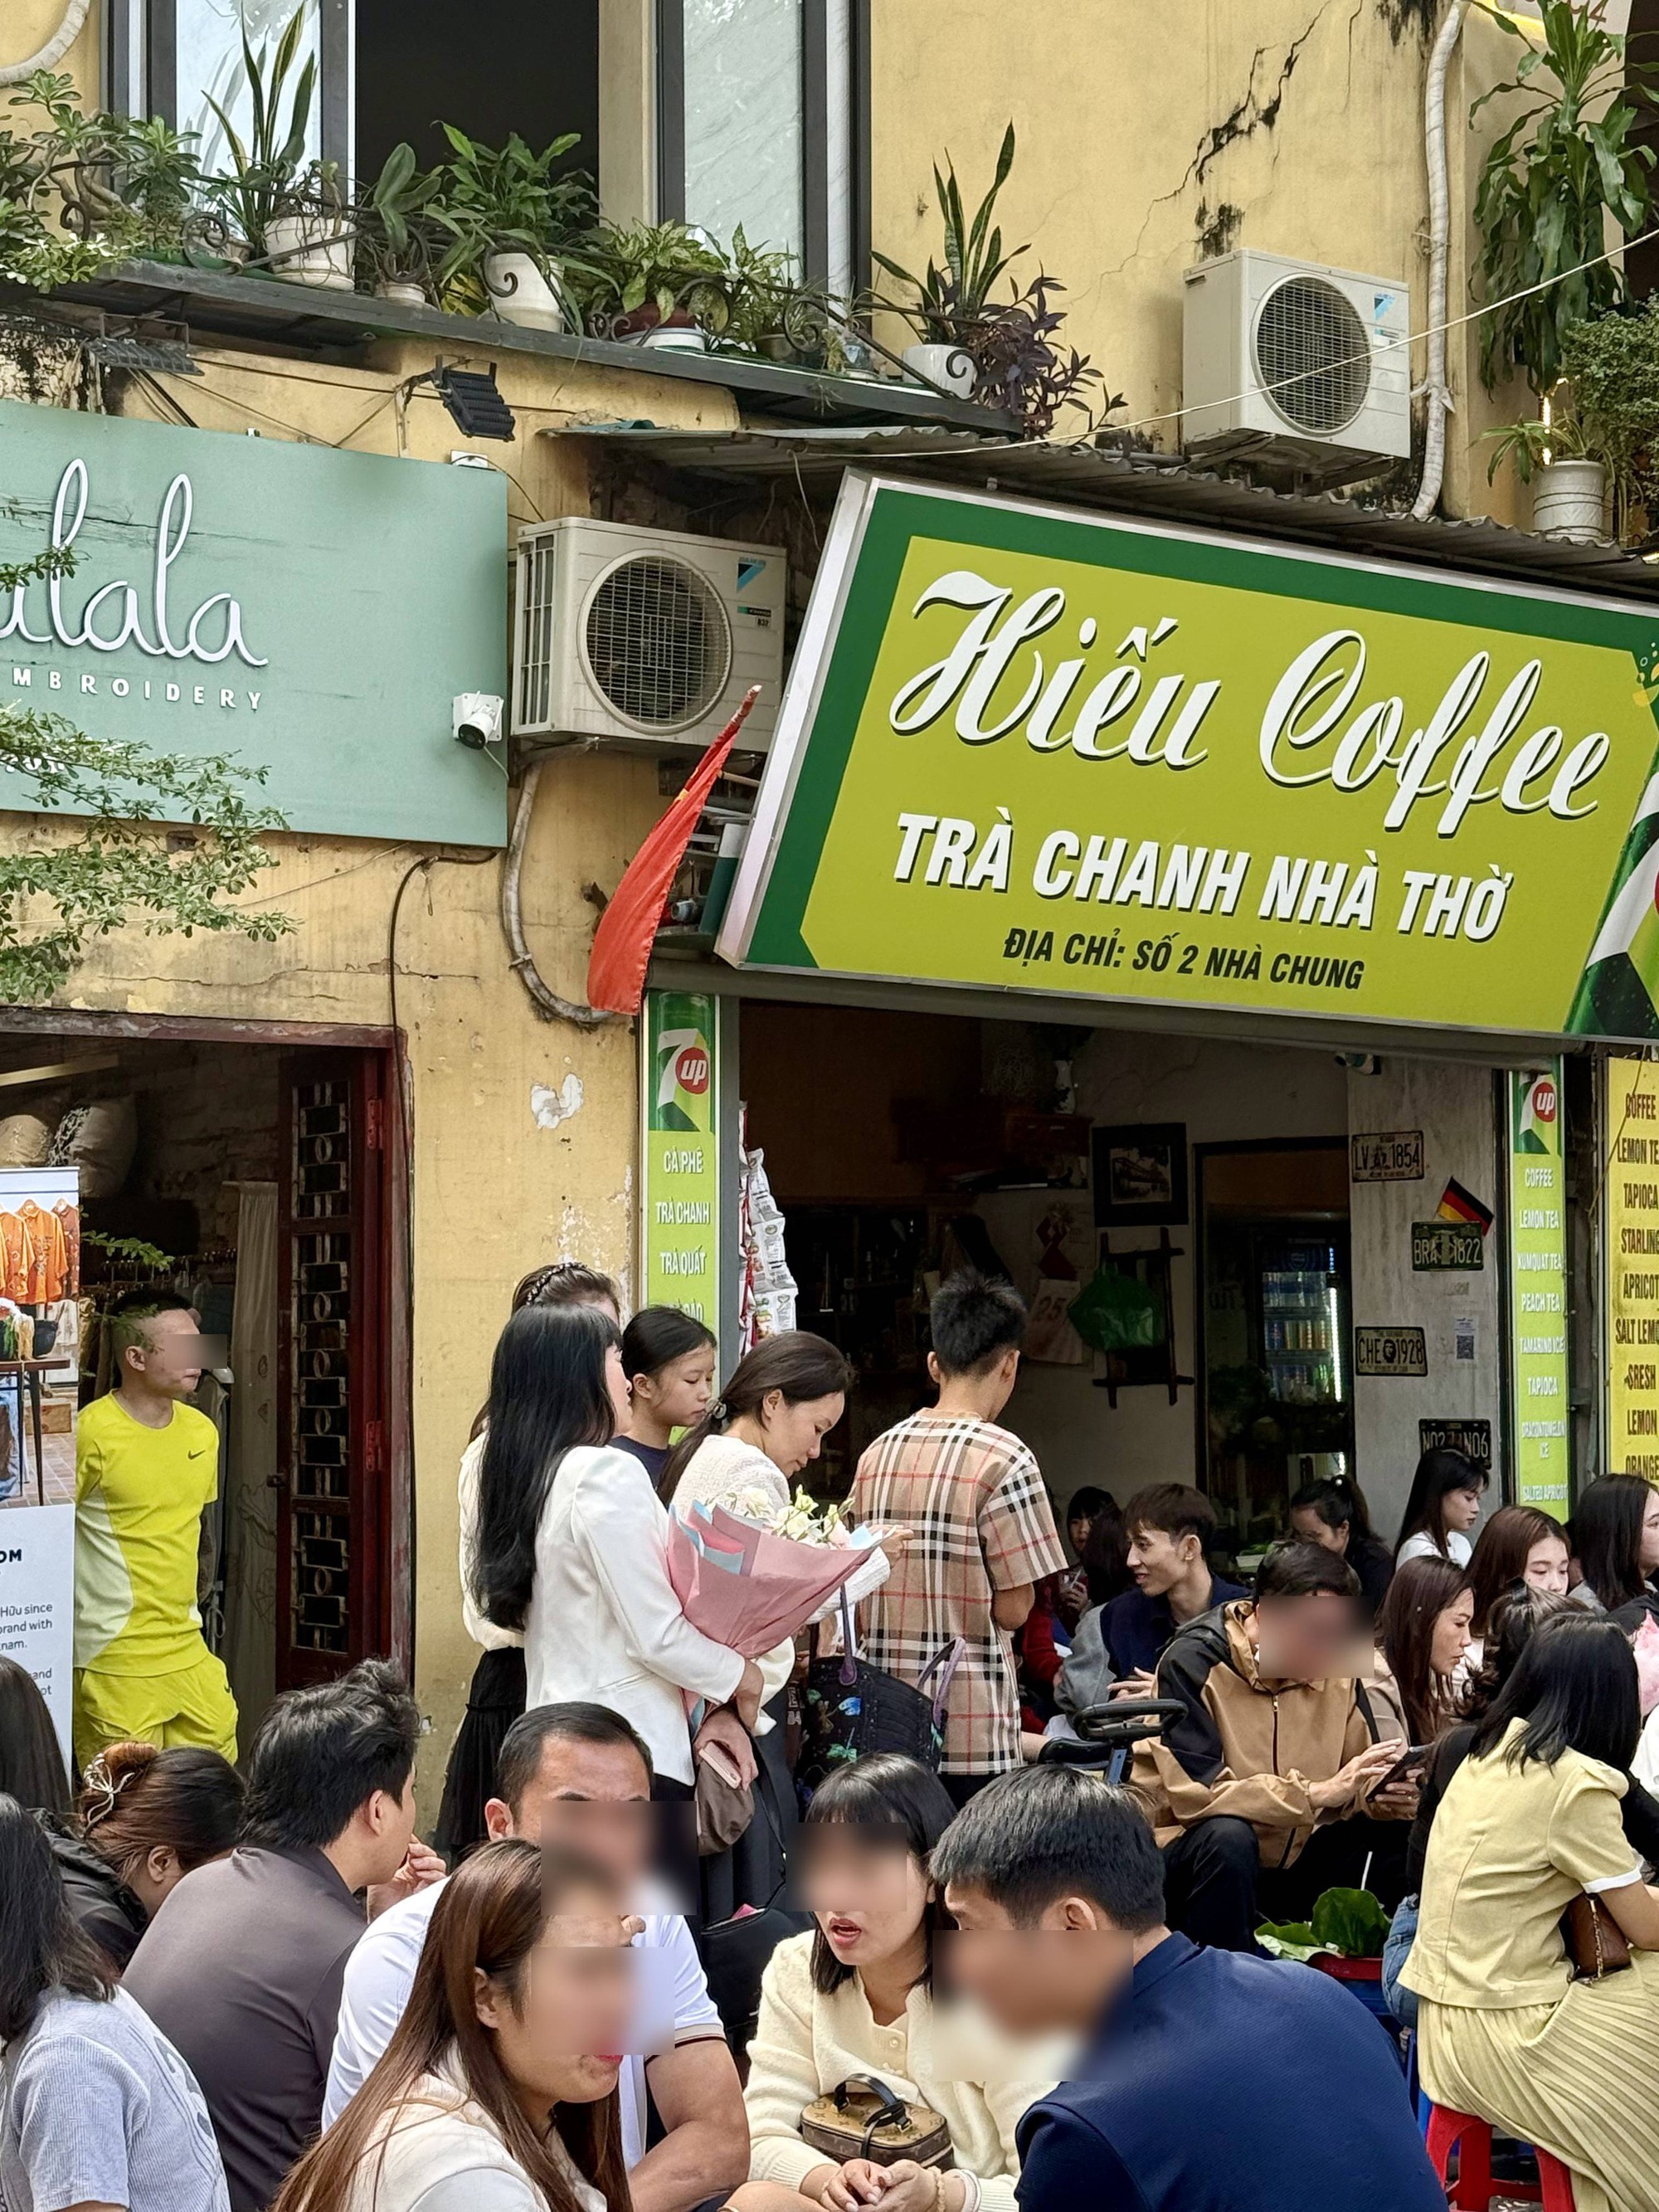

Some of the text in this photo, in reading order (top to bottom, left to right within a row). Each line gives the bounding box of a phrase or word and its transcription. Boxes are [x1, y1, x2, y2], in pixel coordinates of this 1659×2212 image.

[12, 667, 261, 710] MBROIDERY
[889, 571, 1609, 838] Hiếu Coffee
[893, 806, 1014, 893] TRÀ
[1032, 830, 1251, 917] CHANH
[1258, 849, 1379, 930] NHÀ
[1396, 863, 1513, 943] THỜ
[1002, 927, 1365, 990] ĐỊA CHỈ: SỐ 2 NHÀ CHUNG
[1626, 1093, 1657, 1120] COFFEE
[664, 1146, 703, 1174] CÀ PHÊ
[1355, 1143, 1419, 1170] LV 1854
[1617, 1137, 1647, 1165] LEMON
[1525, 1167, 1554, 1188] COFFEE
[1623, 1183, 1659, 1210] TAPIOCA
[655, 1196, 710, 1225] TRÀ CHANH
[1520, 1210, 1559, 1229] LEMON TEA
[659, 1245, 707, 1278] TRÀ QUẤT
[1414, 1238, 1481, 1264] BRA 1822
[1517, 1252, 1564, 1273] KUMQUAT TEA
[1623, 1273, 1659, 1300] APRICOT
[1521, 1293, 1561, 1313] PEACH TEA
[1616, 1318, 1636, 1345] SALT
[1358, 1338, 1423, 1365] CHE 1928
[1527, 1376, 1559, 1396] TAPIOCA
[1627, 1409, 1657, 1435] LEMON
[1625, 1454, 1659, 1480] ORANGE
[24, 1603, 53, 1615] since
[28, 1619, 52, 1630] with
[0, 1640, 27, 1651] nam.
